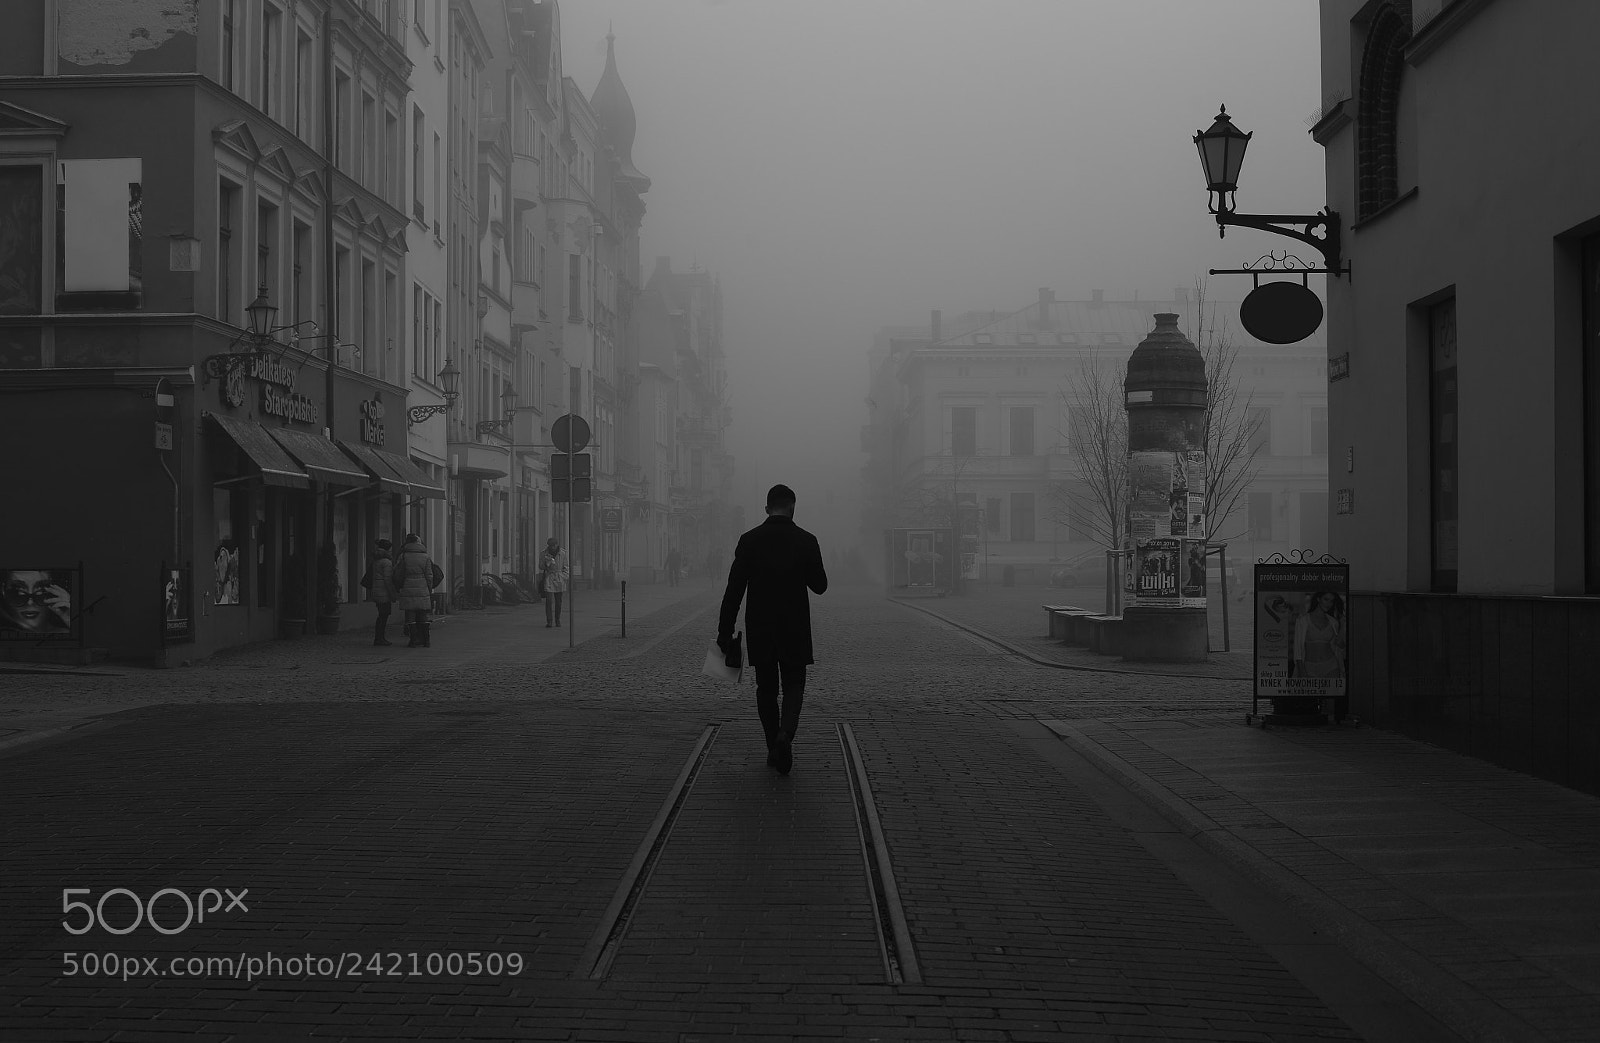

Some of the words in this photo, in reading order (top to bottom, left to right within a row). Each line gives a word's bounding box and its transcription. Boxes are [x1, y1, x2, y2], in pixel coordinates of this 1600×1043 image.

[250, 354, 297, 393] Delikatesy
[265, 383, 318, 424] Staropolskie
[1260, 572, 1298, 583] profesjonalny
[1260, 678, 1282, 688] RYNEK
[1285, 678, 1331, 689] NOWOMIEJSKI
[1335, 679, 1343, 688] 12
